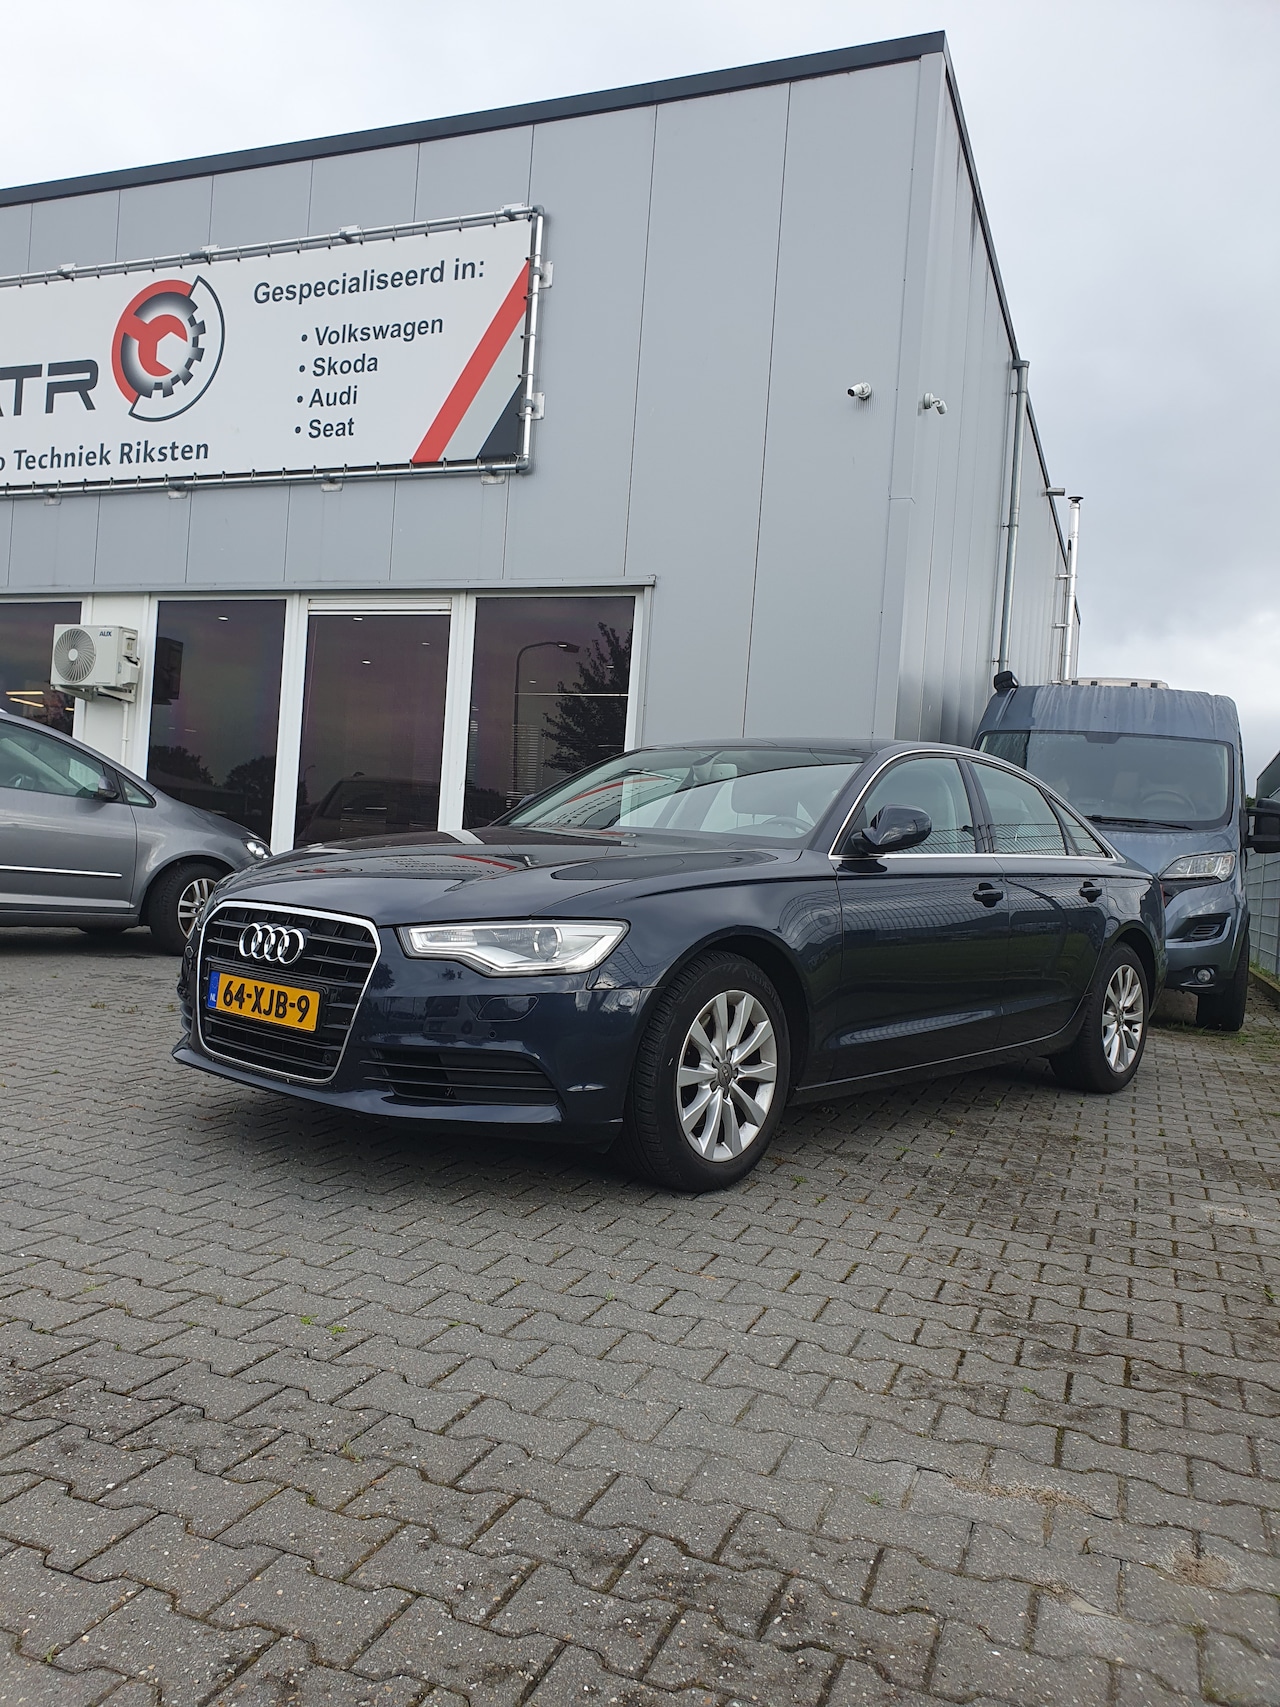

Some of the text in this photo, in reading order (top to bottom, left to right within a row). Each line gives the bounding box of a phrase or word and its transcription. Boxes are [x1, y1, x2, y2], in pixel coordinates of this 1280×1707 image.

[254, 257, 485, 304] Gespecialiseerd in:
[314, 318, 443, 346] Volkswagen
[312, 353, 378, 377] Skoda
[0, 360, 98, 417] TR
[308, 384, 358, 408] Audi
[308, 417, 355, 439] Seat
[14, 442, 112, 471] Techniek
[119, 439, 209, 465] Riksten
[209, 980, 310, 1023] NL 64-XJB-9
